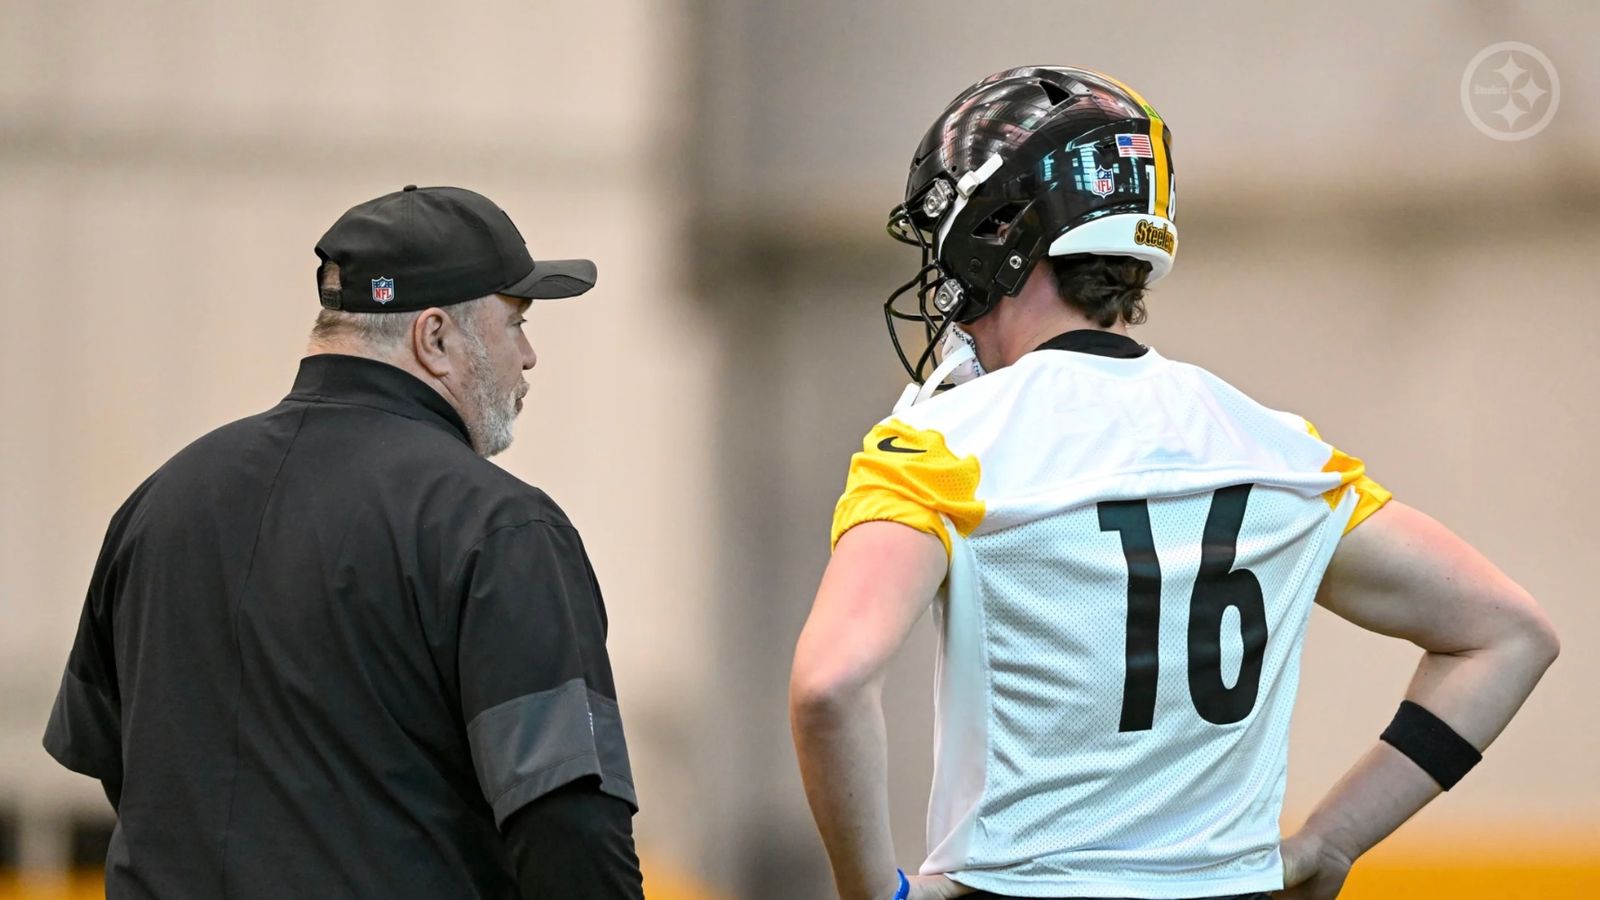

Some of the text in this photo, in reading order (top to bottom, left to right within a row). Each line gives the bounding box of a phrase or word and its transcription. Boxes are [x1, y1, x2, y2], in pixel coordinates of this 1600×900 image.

[1094, 179, 1112, 192] NFL
[375, 287, 392, 300] NFL
[1097, 483, 1268, 732] 16
